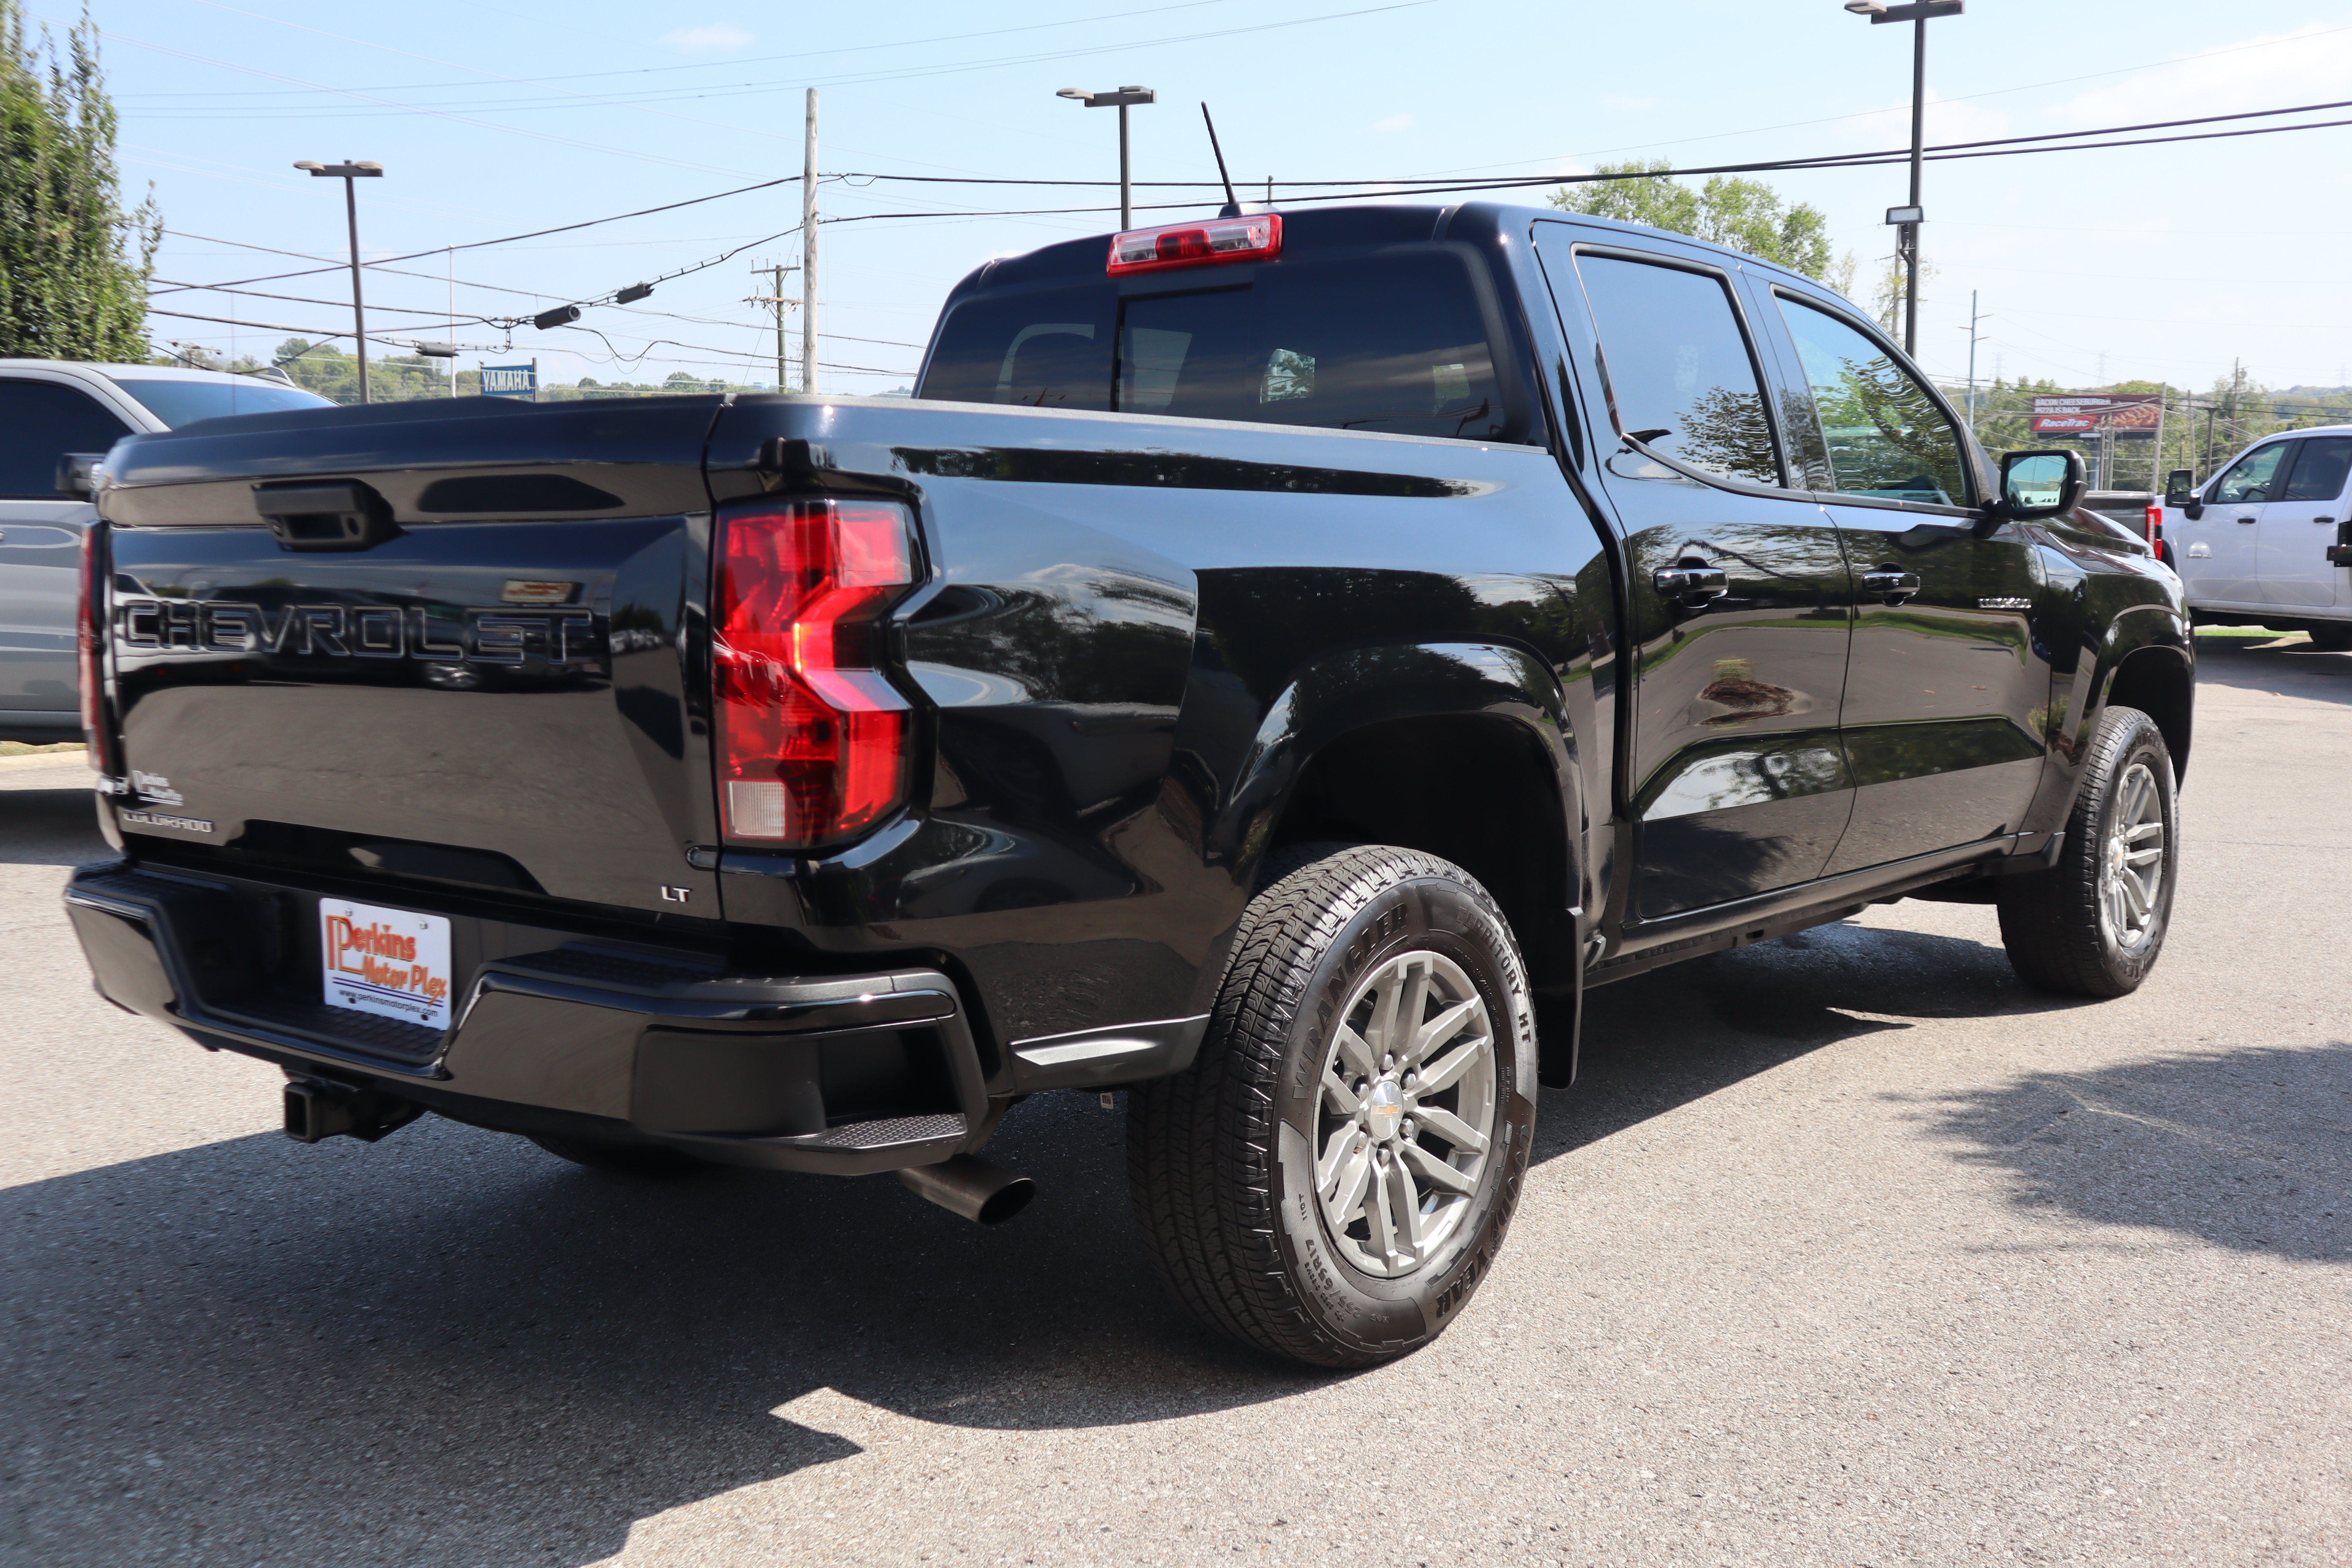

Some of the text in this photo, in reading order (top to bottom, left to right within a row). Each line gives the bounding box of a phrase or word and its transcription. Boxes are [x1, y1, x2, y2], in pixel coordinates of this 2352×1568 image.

[483, 369, 530, 392] YAMAHA
[2040, 418, 2089, 428] RaceTrac
[124, 600, 592, 665] CHEVROLET
[662, 886, 691, 902] LT
[326, 914, 416, 969] Perkins
[363, 955, 447, 1006] Motor Plex
[1293, 902, 1407, 1099] WRANGLER
[1457, 906, 1522, 996] TERRITORY
[1519, 1012, 1531, 1043] HT
[339, 989, 438, 1017] www.perkinsmotorplex.com
[1436, 1124, 1531, 1319] GOODYEAR
[1305, 1239, 1363, 1319] 255/65R17
